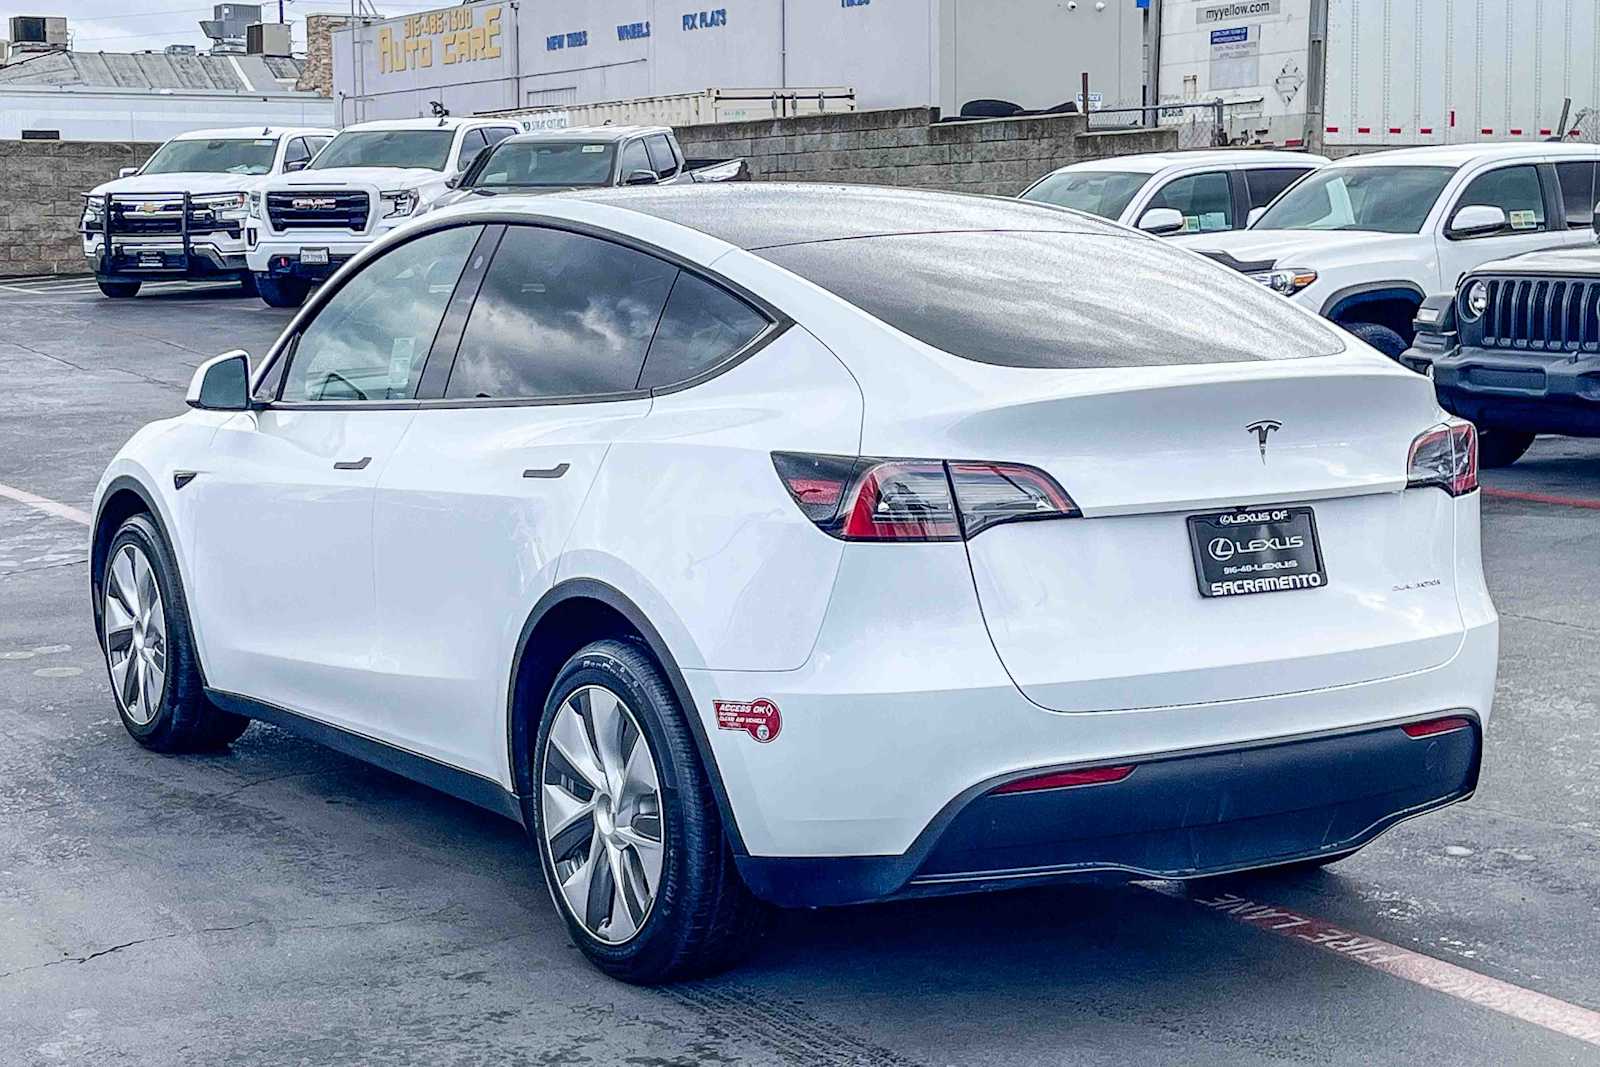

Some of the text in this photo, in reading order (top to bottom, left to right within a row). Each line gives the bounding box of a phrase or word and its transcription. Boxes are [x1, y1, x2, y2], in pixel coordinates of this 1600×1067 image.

[700, 9, 727, 28] FLATS
[1206, 2, 1270, 21] myyellow.com
[443, 8, 502, 65] CARE
[616, 21, 651, 41] WHEELS
[546, 34, 566, 51] NEW
[292, 198, 336, 209] GMC
[1230, 509, 1289, 524] LEXUS OF
[1235, 535, 1304, 553] LEXUS
[1211, 573, 1321, 596] SACRAMENTO
[719, 704, 766, 714] ACCESS OK
